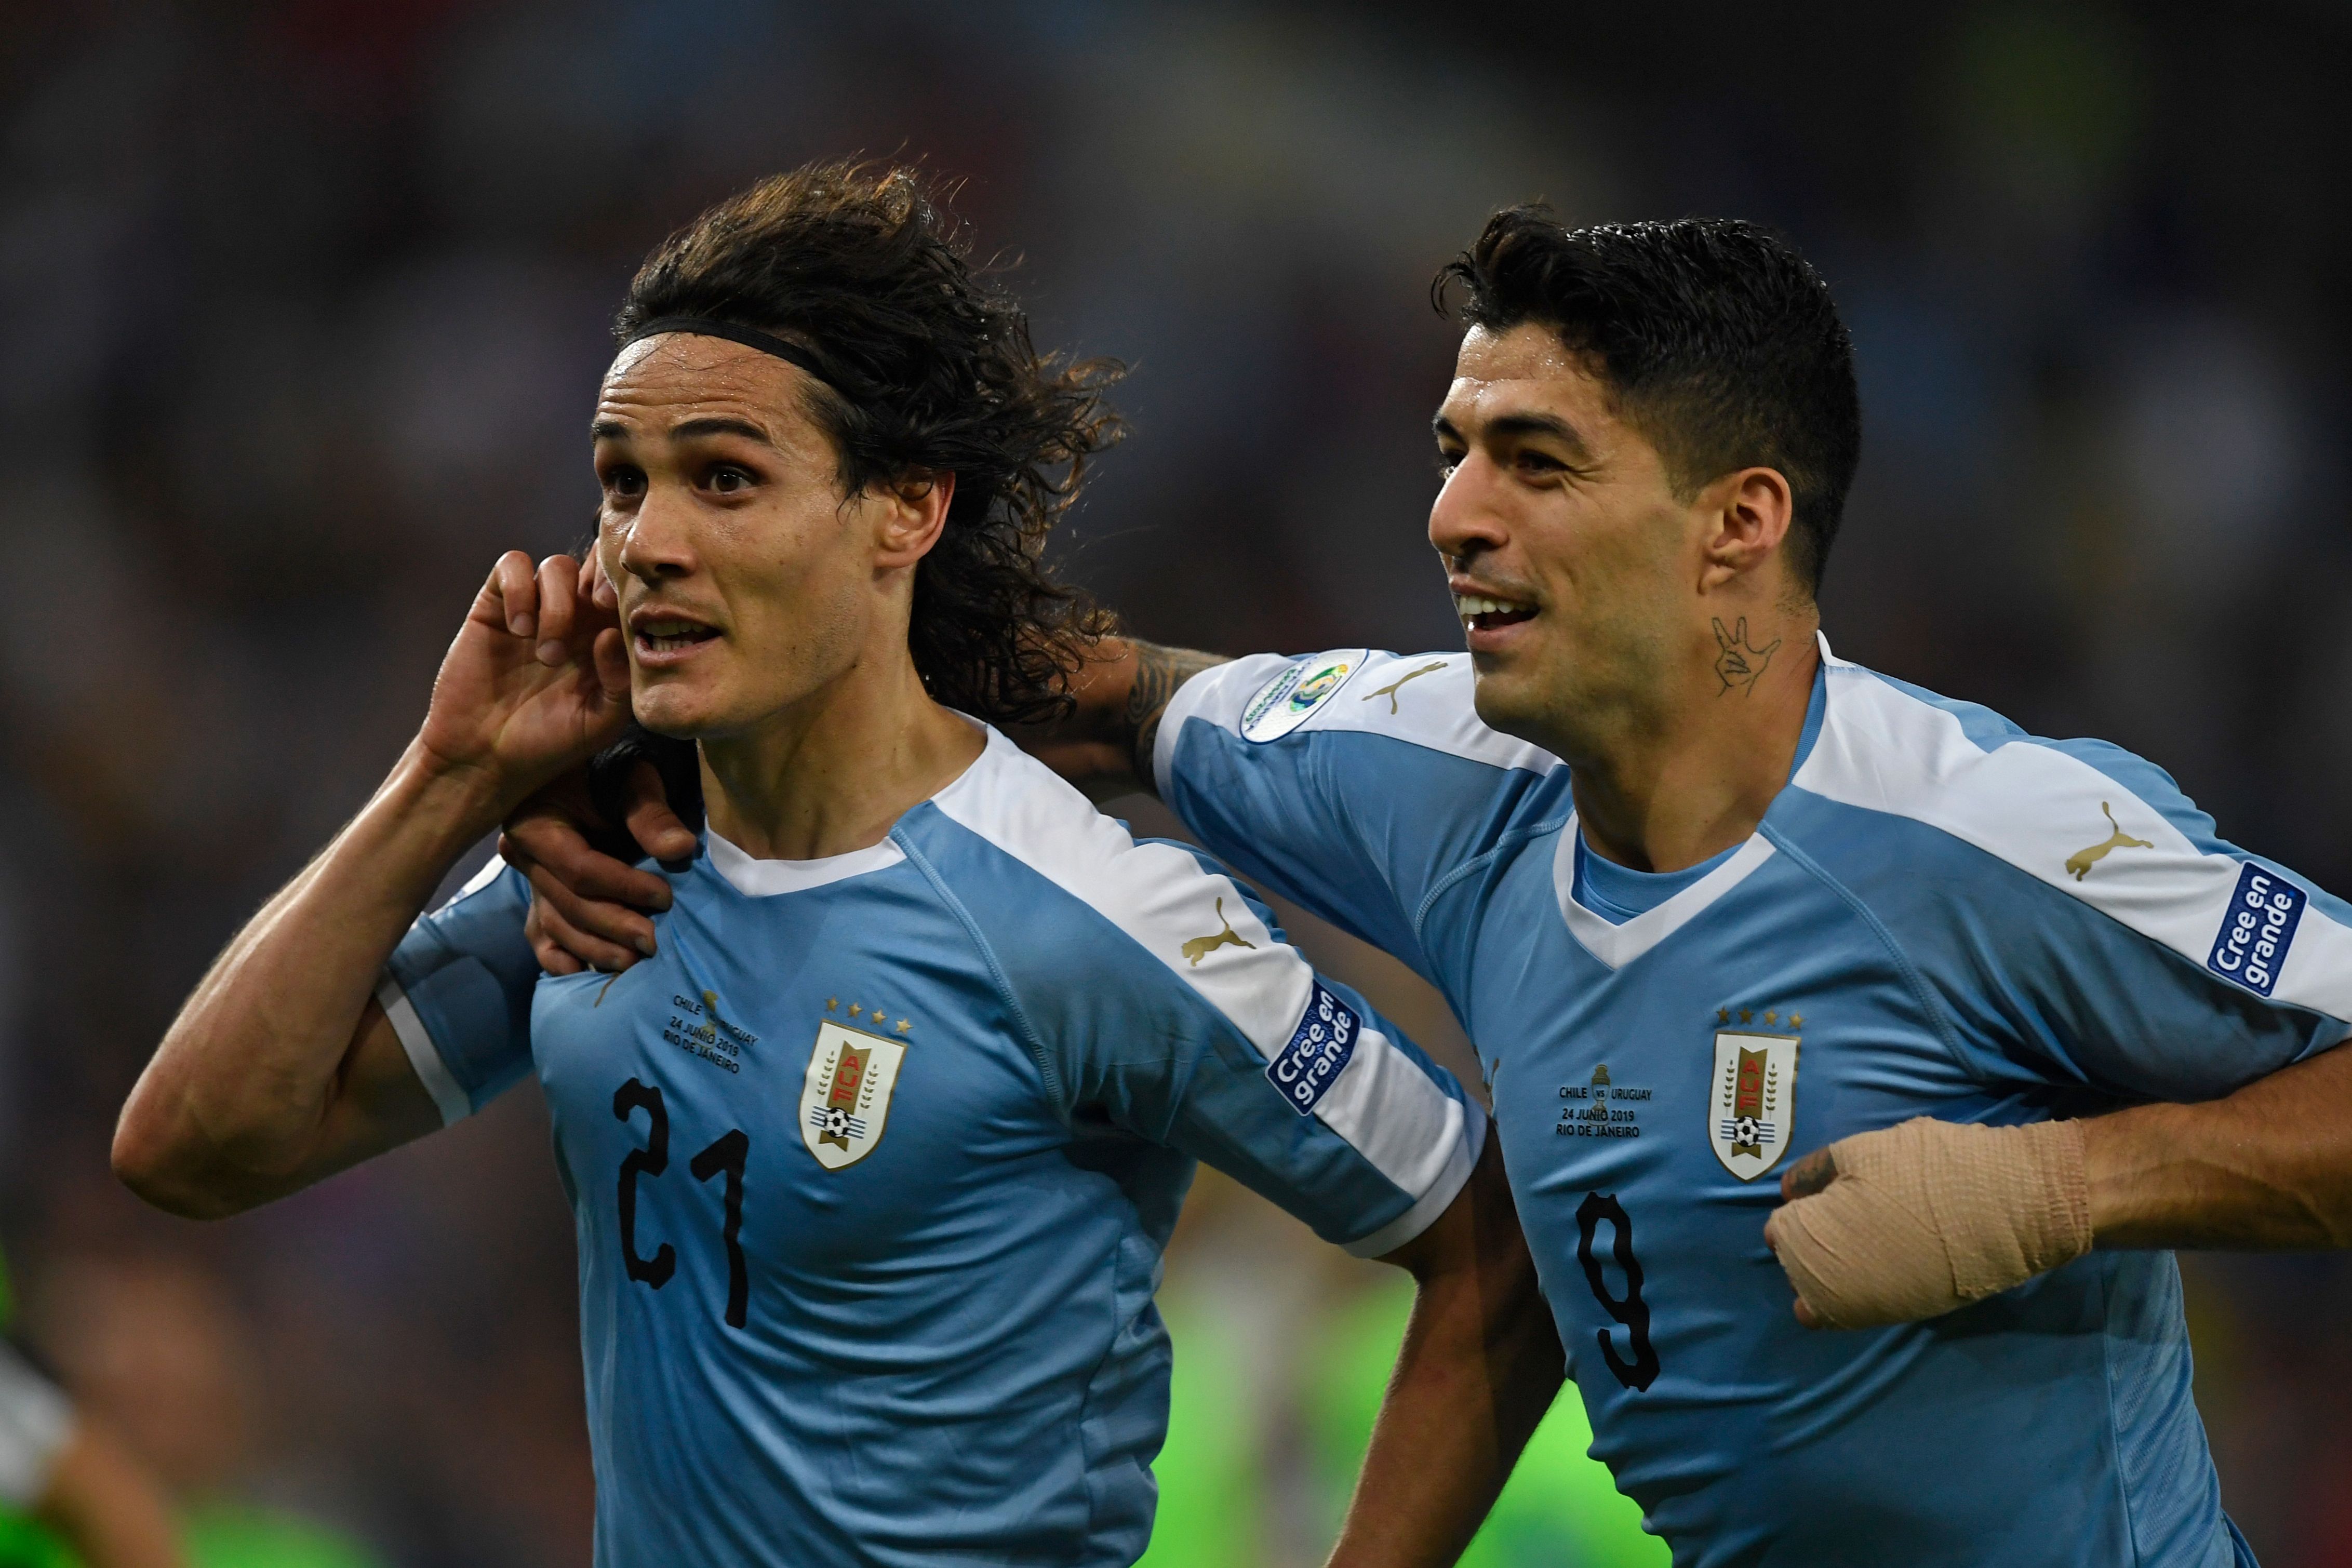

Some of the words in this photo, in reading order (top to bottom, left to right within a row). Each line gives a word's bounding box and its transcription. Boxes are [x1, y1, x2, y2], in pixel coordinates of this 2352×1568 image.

[2216, 912, 2256, 971] Cree
[2246, 875, 2271, 908] en
[2245, 893, 2292, 988] grande
[674, 995, 702, 1015] CHILE
[664, 1029, 680, 1046] RIO
[683, 1039, 696, 1053] DE
[697, 1047, 739, 1074] JANEIRO
[670, 1016, 683, 1029] 24
[683, 1023, 715, 1044] JUNIO
[716, 1038, 739, 1056] 2019
[1277, 1023, 1325, 1082] Cree
[1319, 990, 1334, 1022] en
[1294, 1011, 1351, 1105] grande
[833, 1055, 860, 1101] AUF
[1559, 1087, 1587, 1098] CHILE
[1611, 1089, 1652, 1101] URUGUAY
[1739, 1058, 1759, 1110] AUF
[1556, 1124, 1574, 1135] RIO
[1578, 1125, 1592, 1136] DE
[1595, 1125, 1640, 1137] JANEIRO
[1562, 1108, 1574, 1120] 24
[1576, 1109, 1608, 1121] JUNIO
[1611, 1110, 1635, 1121] 2019
[613, 1077, 749, 1330] 21
[1575, 1191, 1661, 1392] 9
